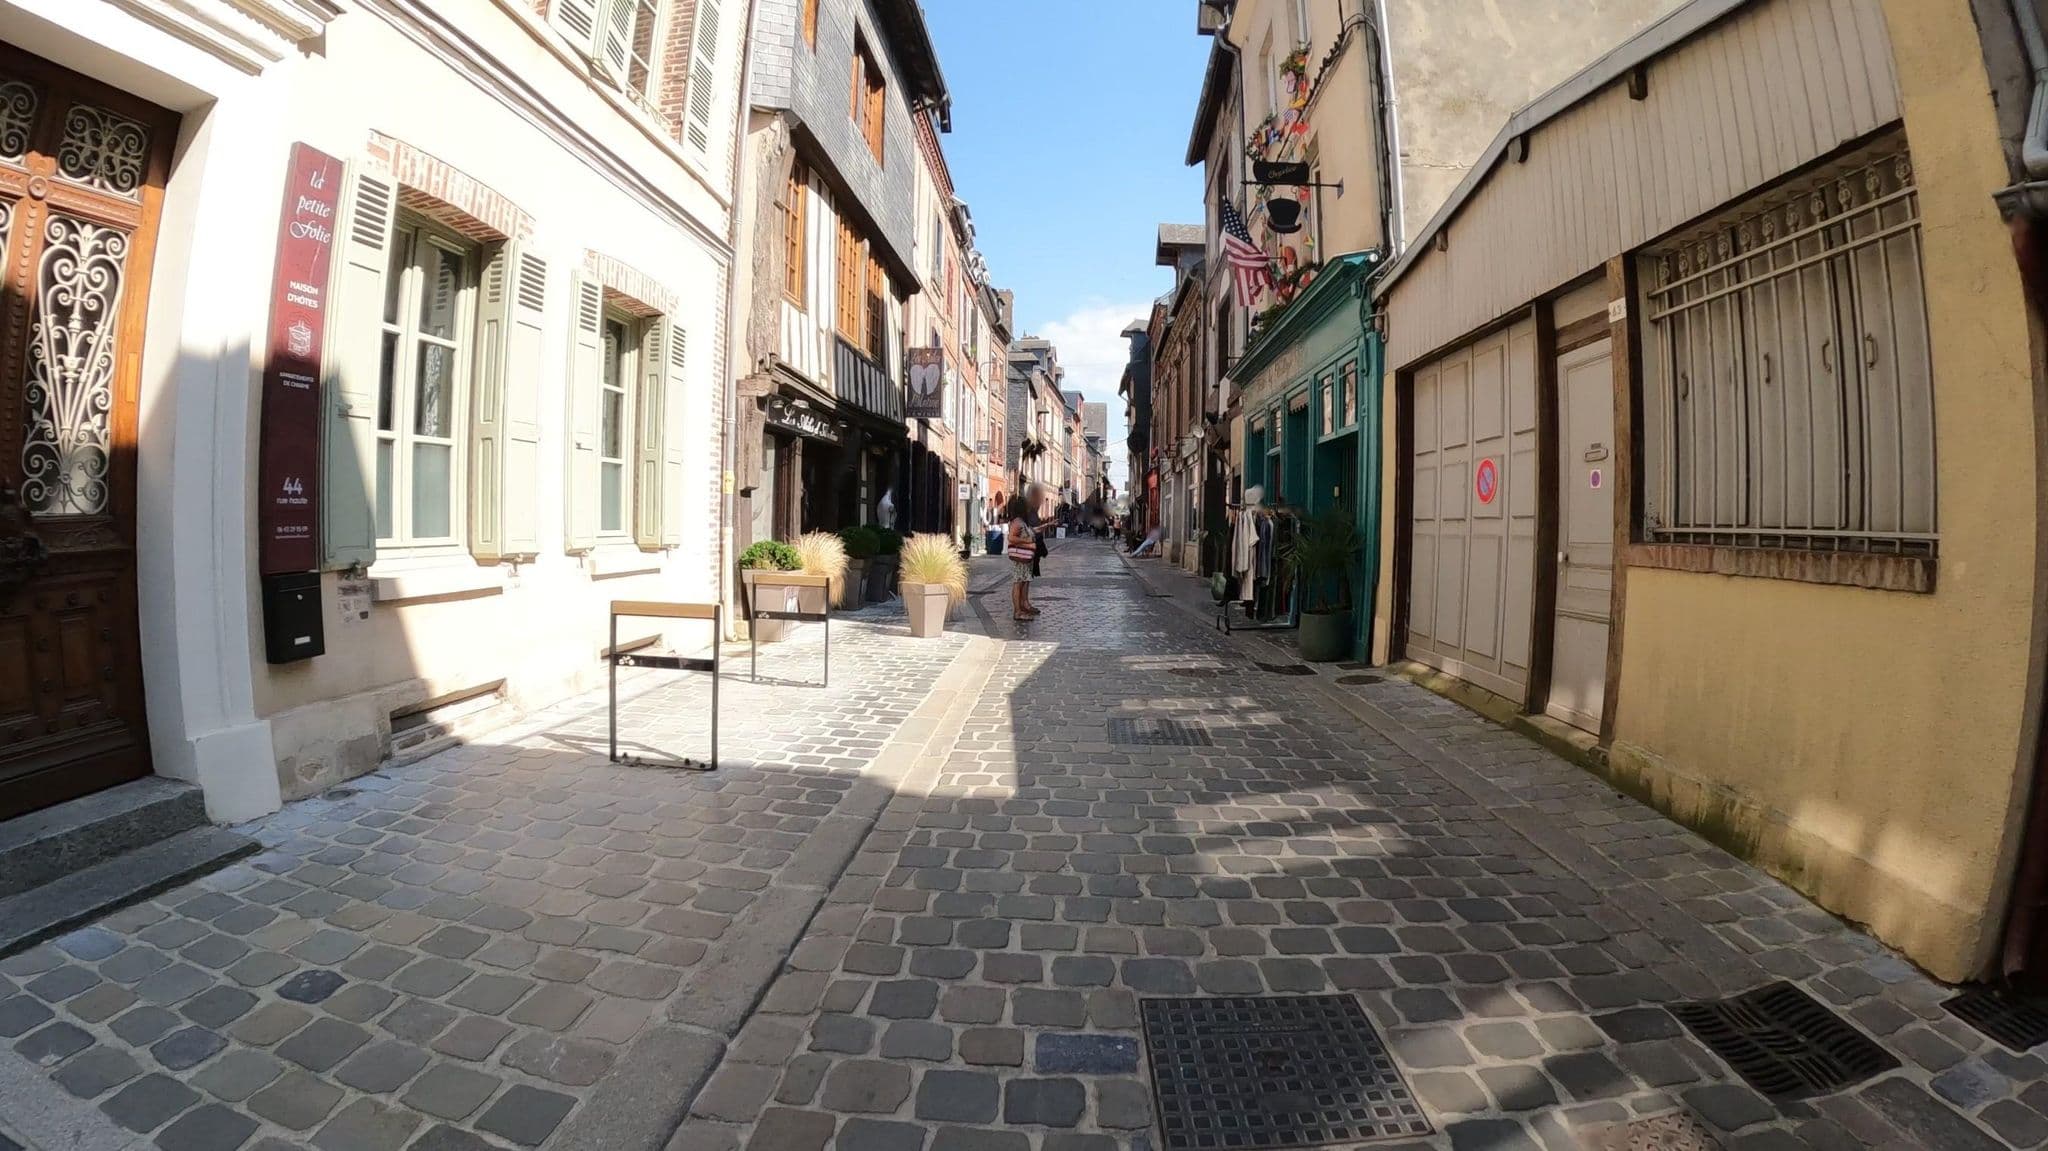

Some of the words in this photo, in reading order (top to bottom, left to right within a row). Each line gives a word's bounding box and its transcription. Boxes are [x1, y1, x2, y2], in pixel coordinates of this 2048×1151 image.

[296, 195, 331, 218] petite
[289, 220, 332, 244] Folie
[289, 280, 319, 296] MAISON
[287, 292, 319, 309] D'HÔTES
[282, 476, 303, 495] 44
